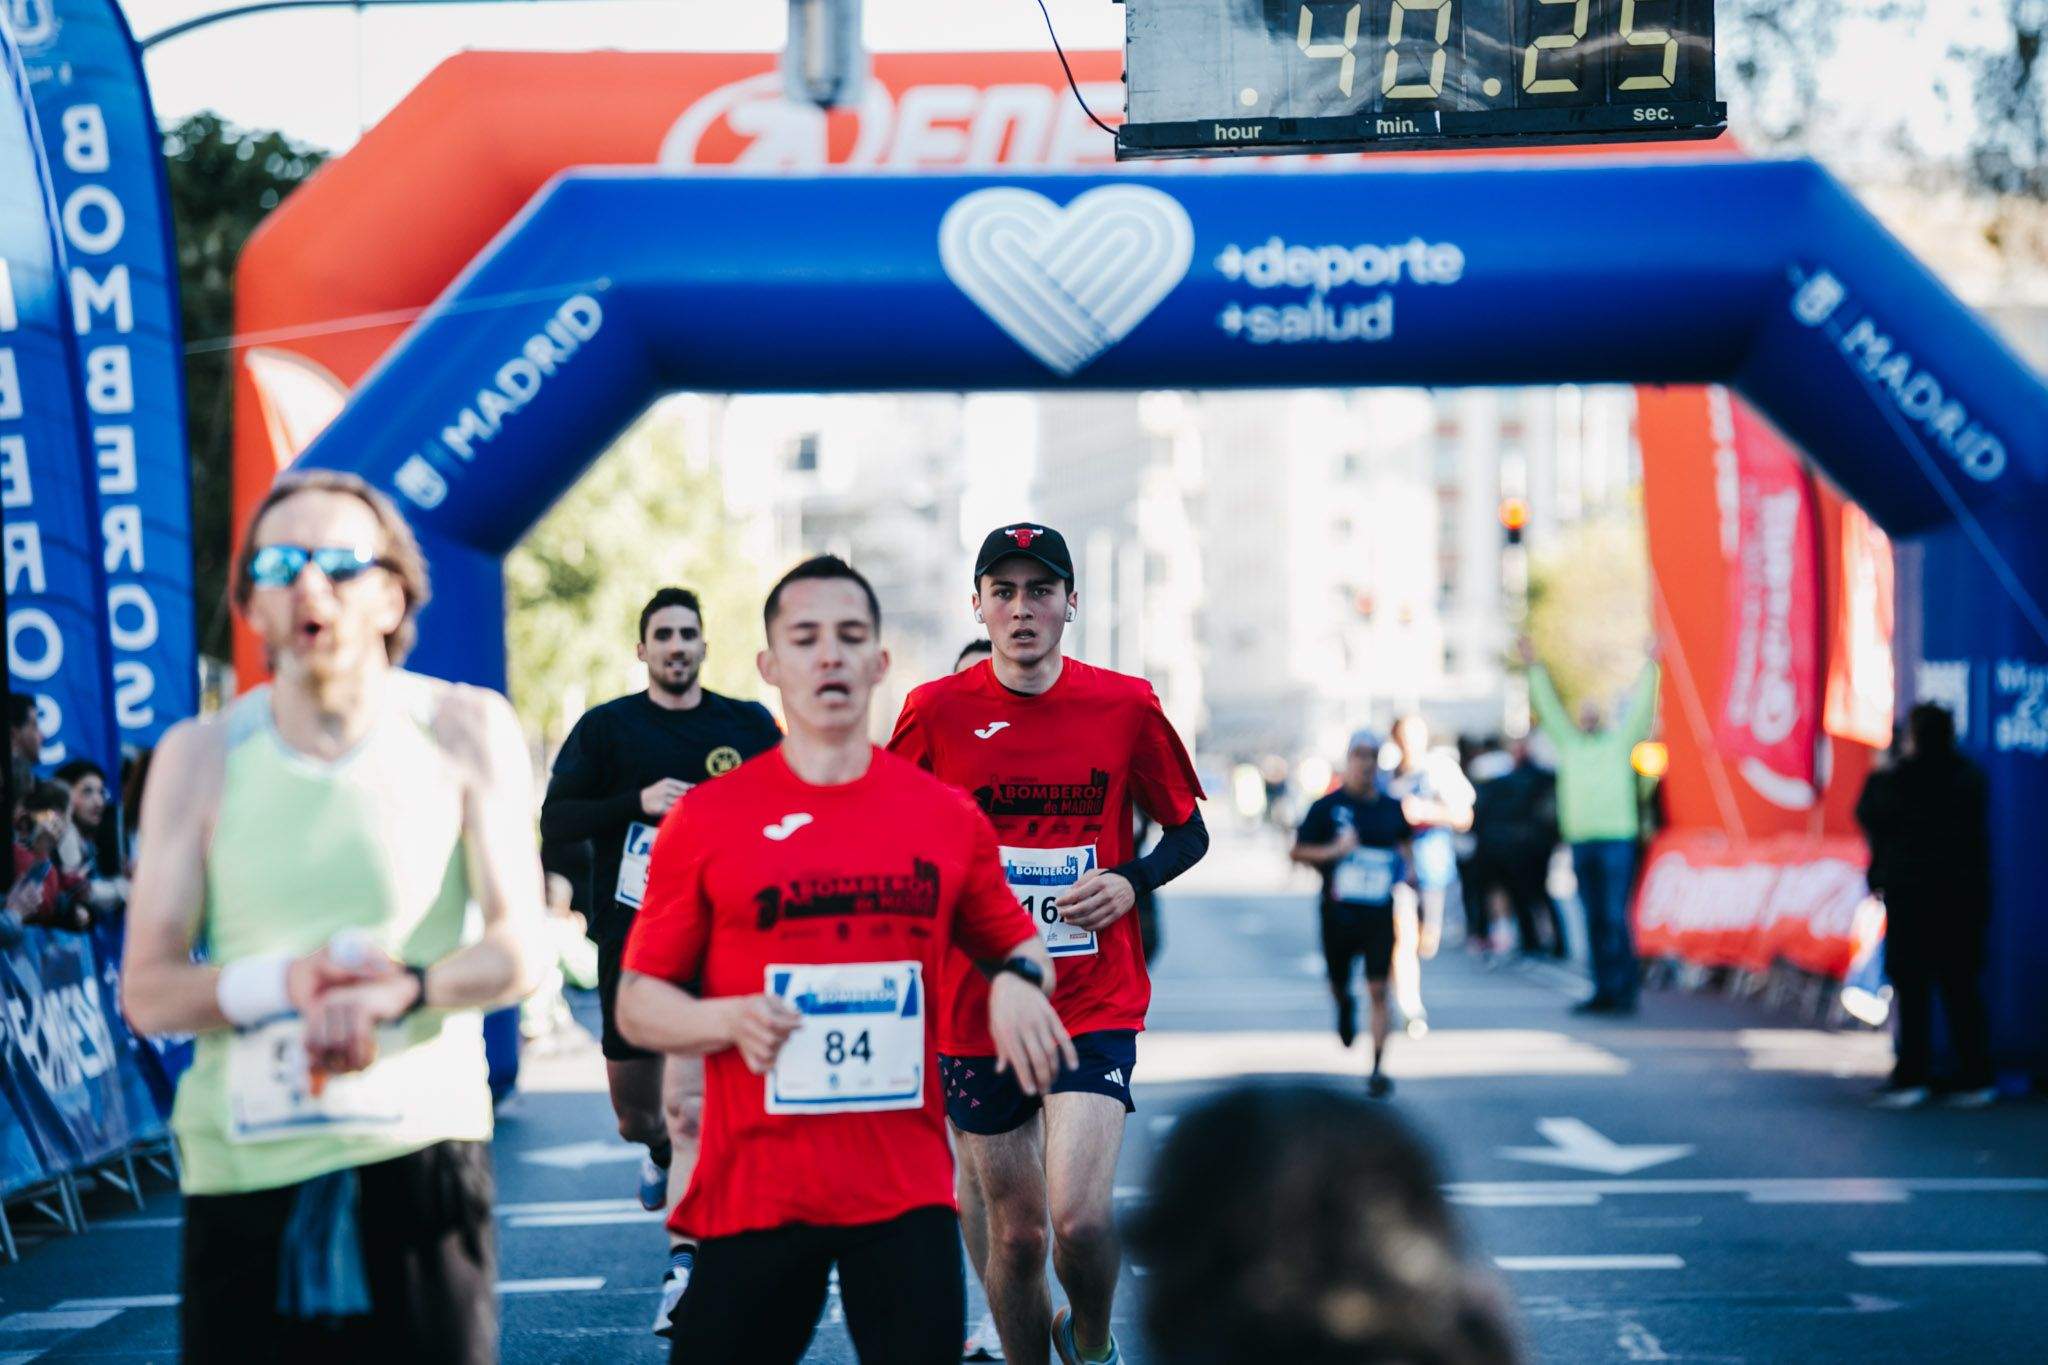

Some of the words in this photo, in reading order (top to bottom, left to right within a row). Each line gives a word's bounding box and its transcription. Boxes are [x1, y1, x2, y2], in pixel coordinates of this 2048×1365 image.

[1632, 107, 1675, 122] sec.
[1215, 124, 1262, 140] hour
[1376, 116, 1420, 134] min.
[441, 294, 603, 463] MADRID
[1841, 316, 2007, 482] MADRID
[1005, 785, 1104, 800] BOMBEROS
[1016, 866, 1077, 877] BOMBEROS
[1021, 895, 1066, 925] 16
[825, 1030, 872, 1065] 84
